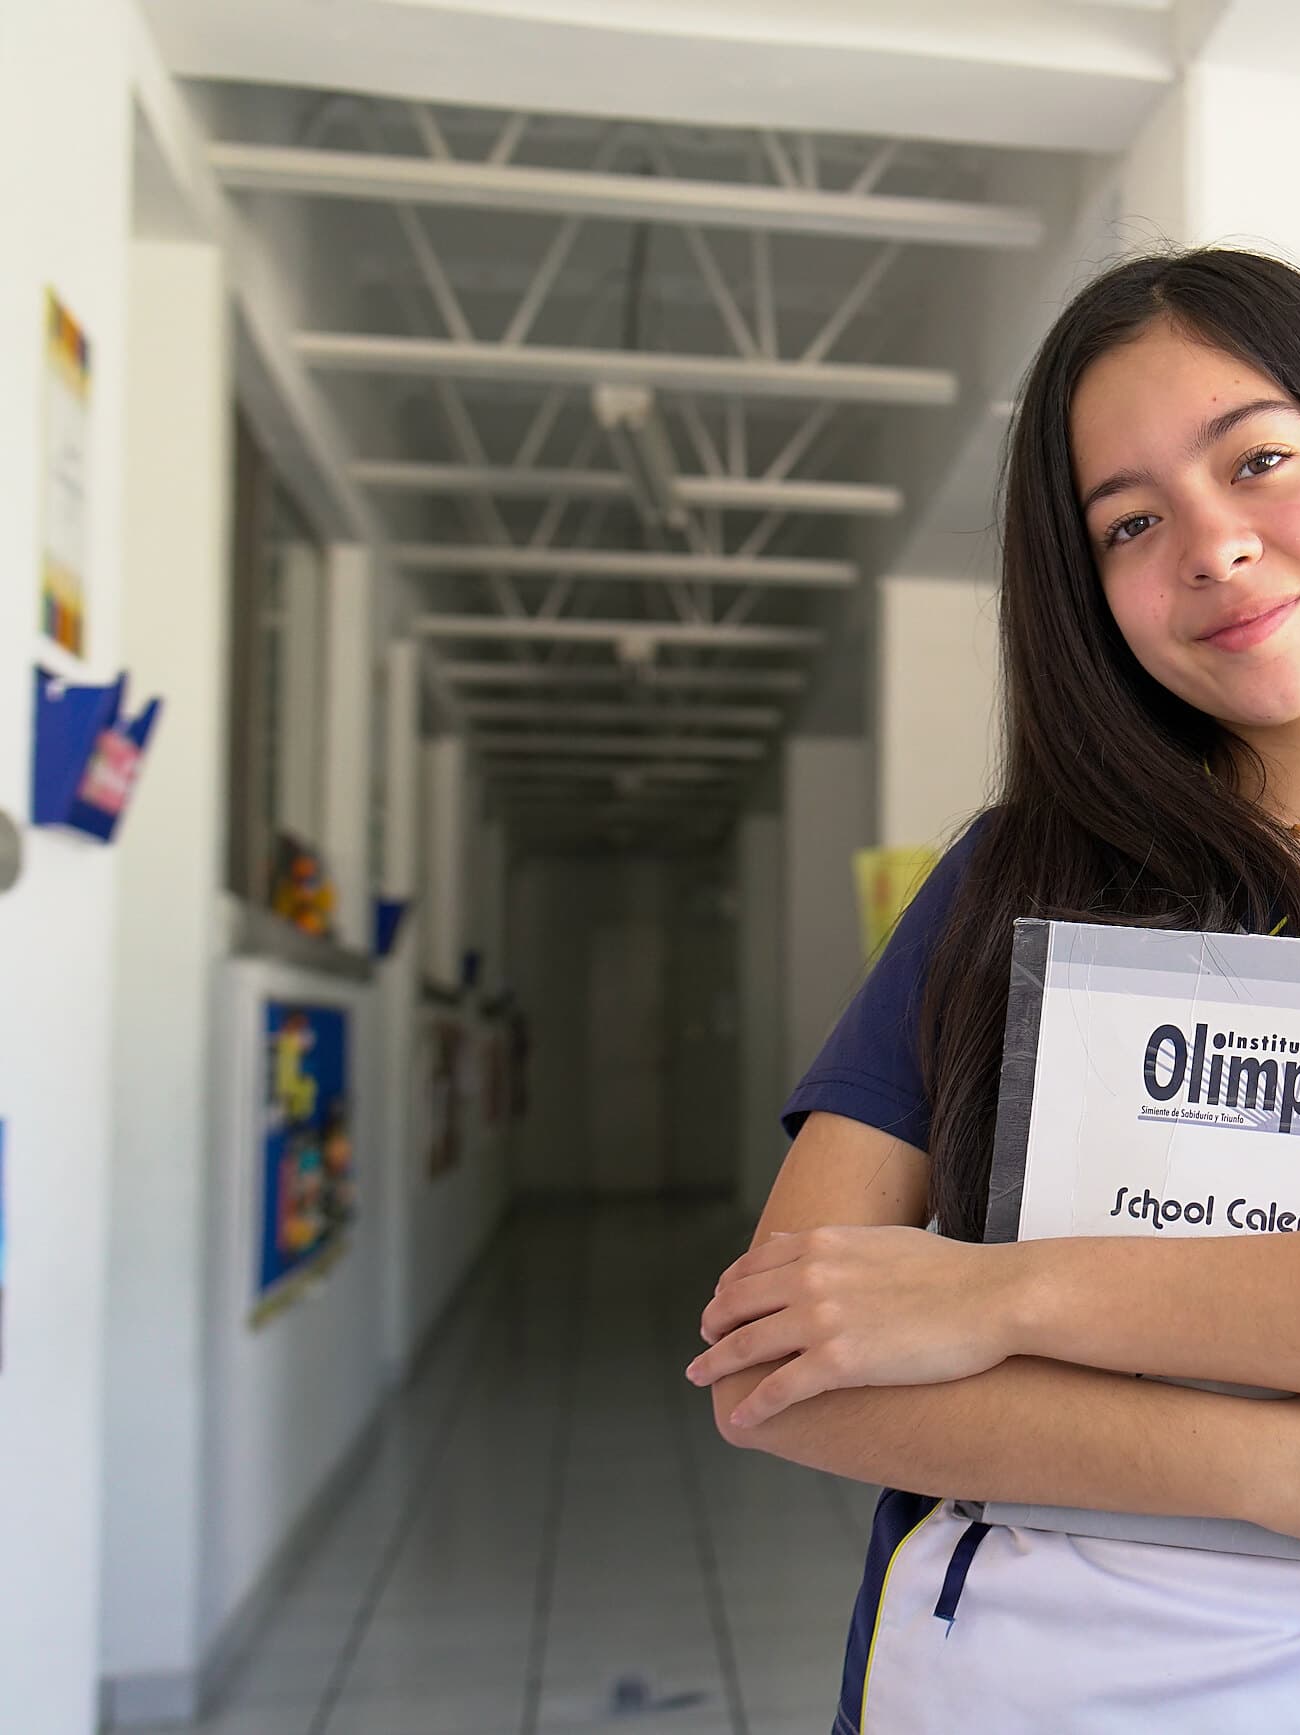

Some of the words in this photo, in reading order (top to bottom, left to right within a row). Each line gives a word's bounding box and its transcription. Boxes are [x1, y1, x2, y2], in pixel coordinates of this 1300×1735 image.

[1141, 1105, 1170, 1117] Simiente
[1171, 1107, 1180, 1118] de
[1214, 1114, 1220, 1123] y
[1220, 1112, 1244, 1124] Triunfo
[1110, 1187, 1215, 1229] School
